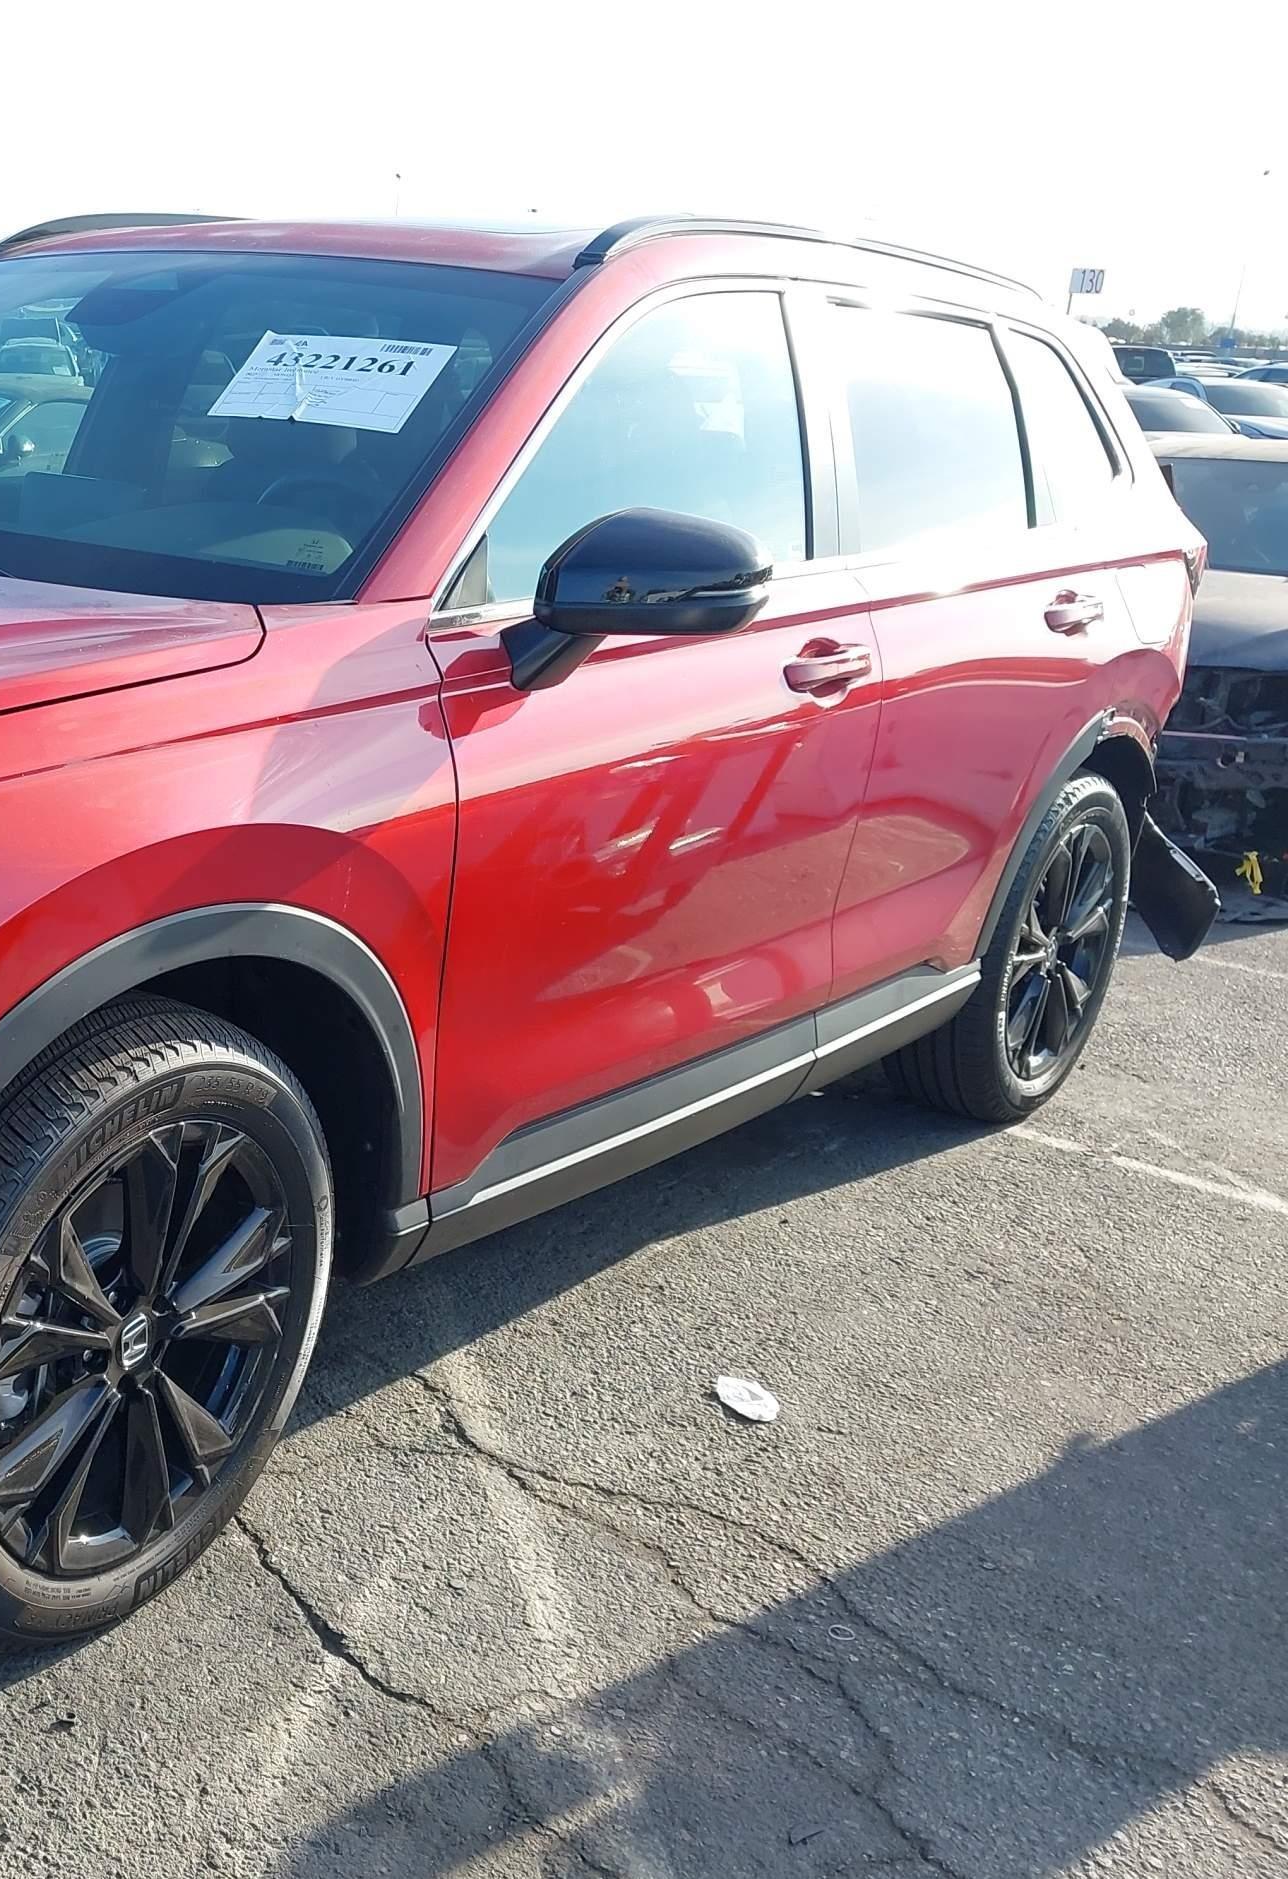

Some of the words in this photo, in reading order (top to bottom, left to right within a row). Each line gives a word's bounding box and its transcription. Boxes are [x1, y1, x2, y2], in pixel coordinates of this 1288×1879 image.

[1079, 269, 1104, 293] 130
[266, 351, 416, 376] 43221261
[56, 1083, 179, 1187] MICHELIN
